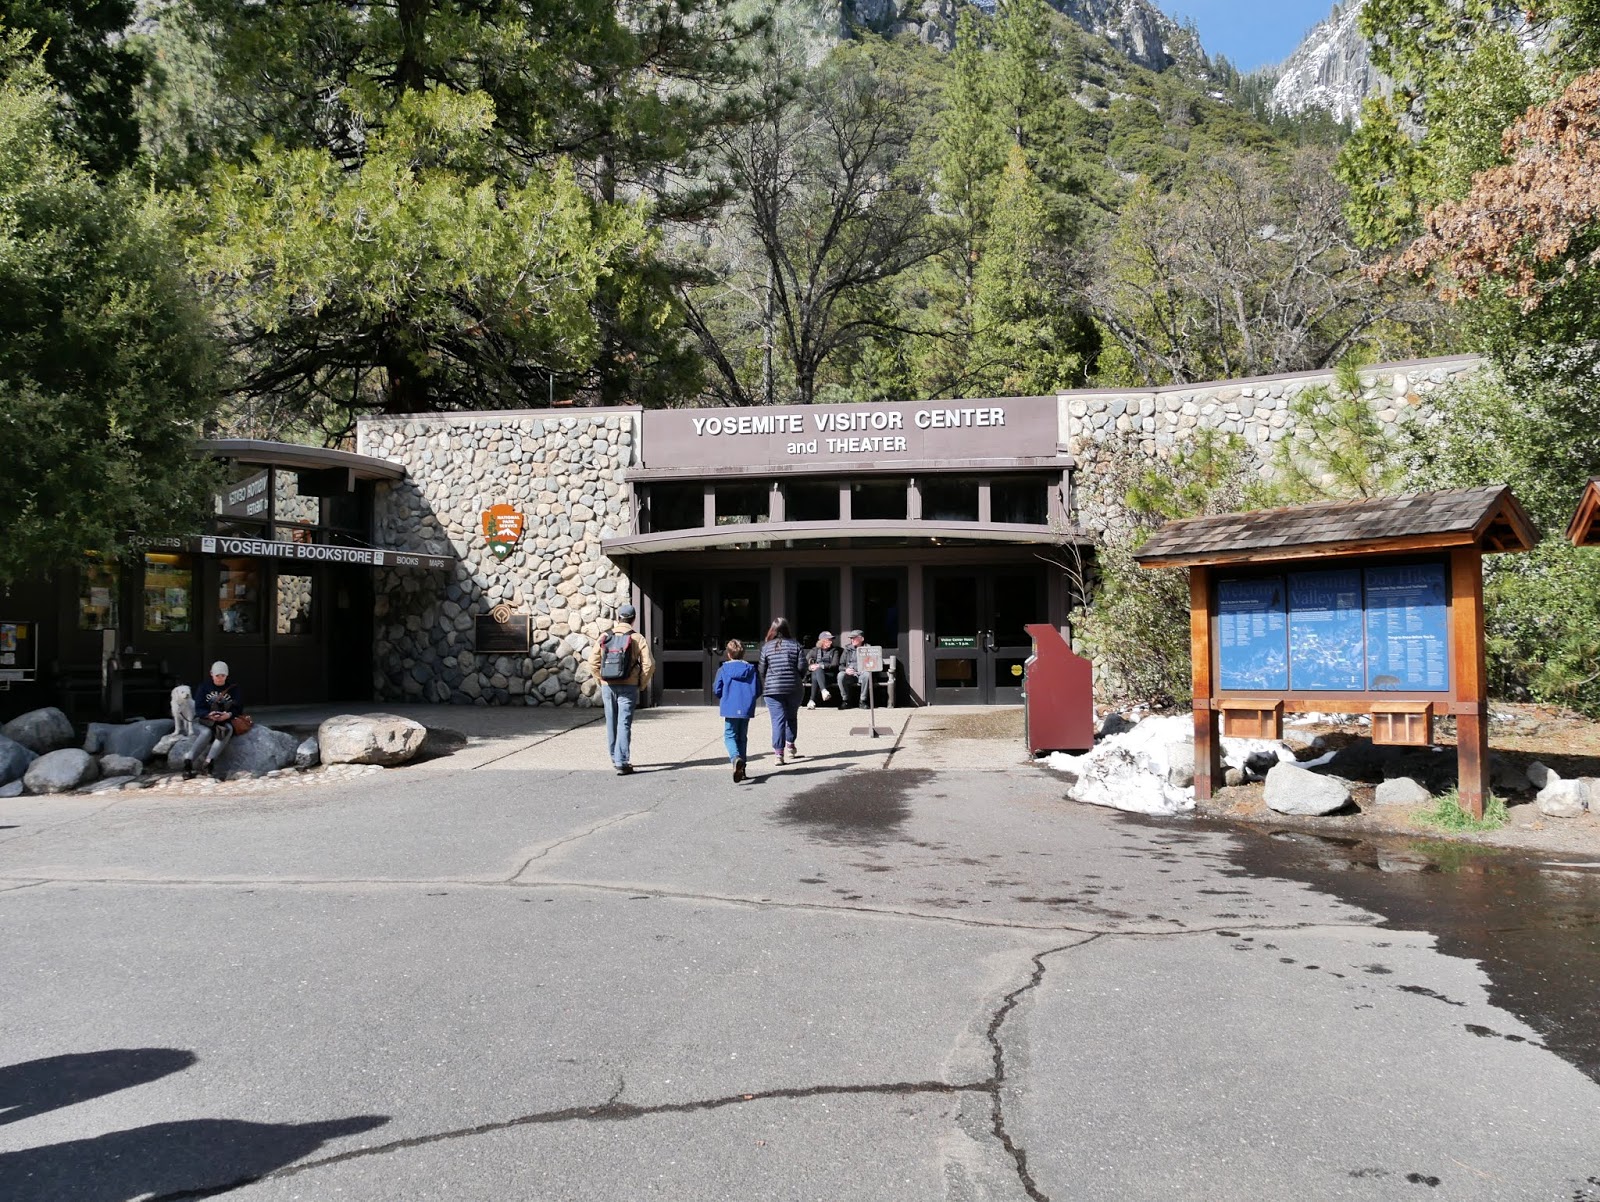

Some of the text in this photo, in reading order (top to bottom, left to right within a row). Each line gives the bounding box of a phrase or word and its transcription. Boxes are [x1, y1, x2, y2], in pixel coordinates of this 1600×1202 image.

[692, 407, 1005, 435] YOSEMITE VISITOR CENTER
[787, 436, 907, 454] and THEATER
[220, 540, 371, 563] YOSEMITE BOOKSTORE
[396, 556, 445, 568] BOOKS MAPS
[1291, 590, 1335, 607] Valley
